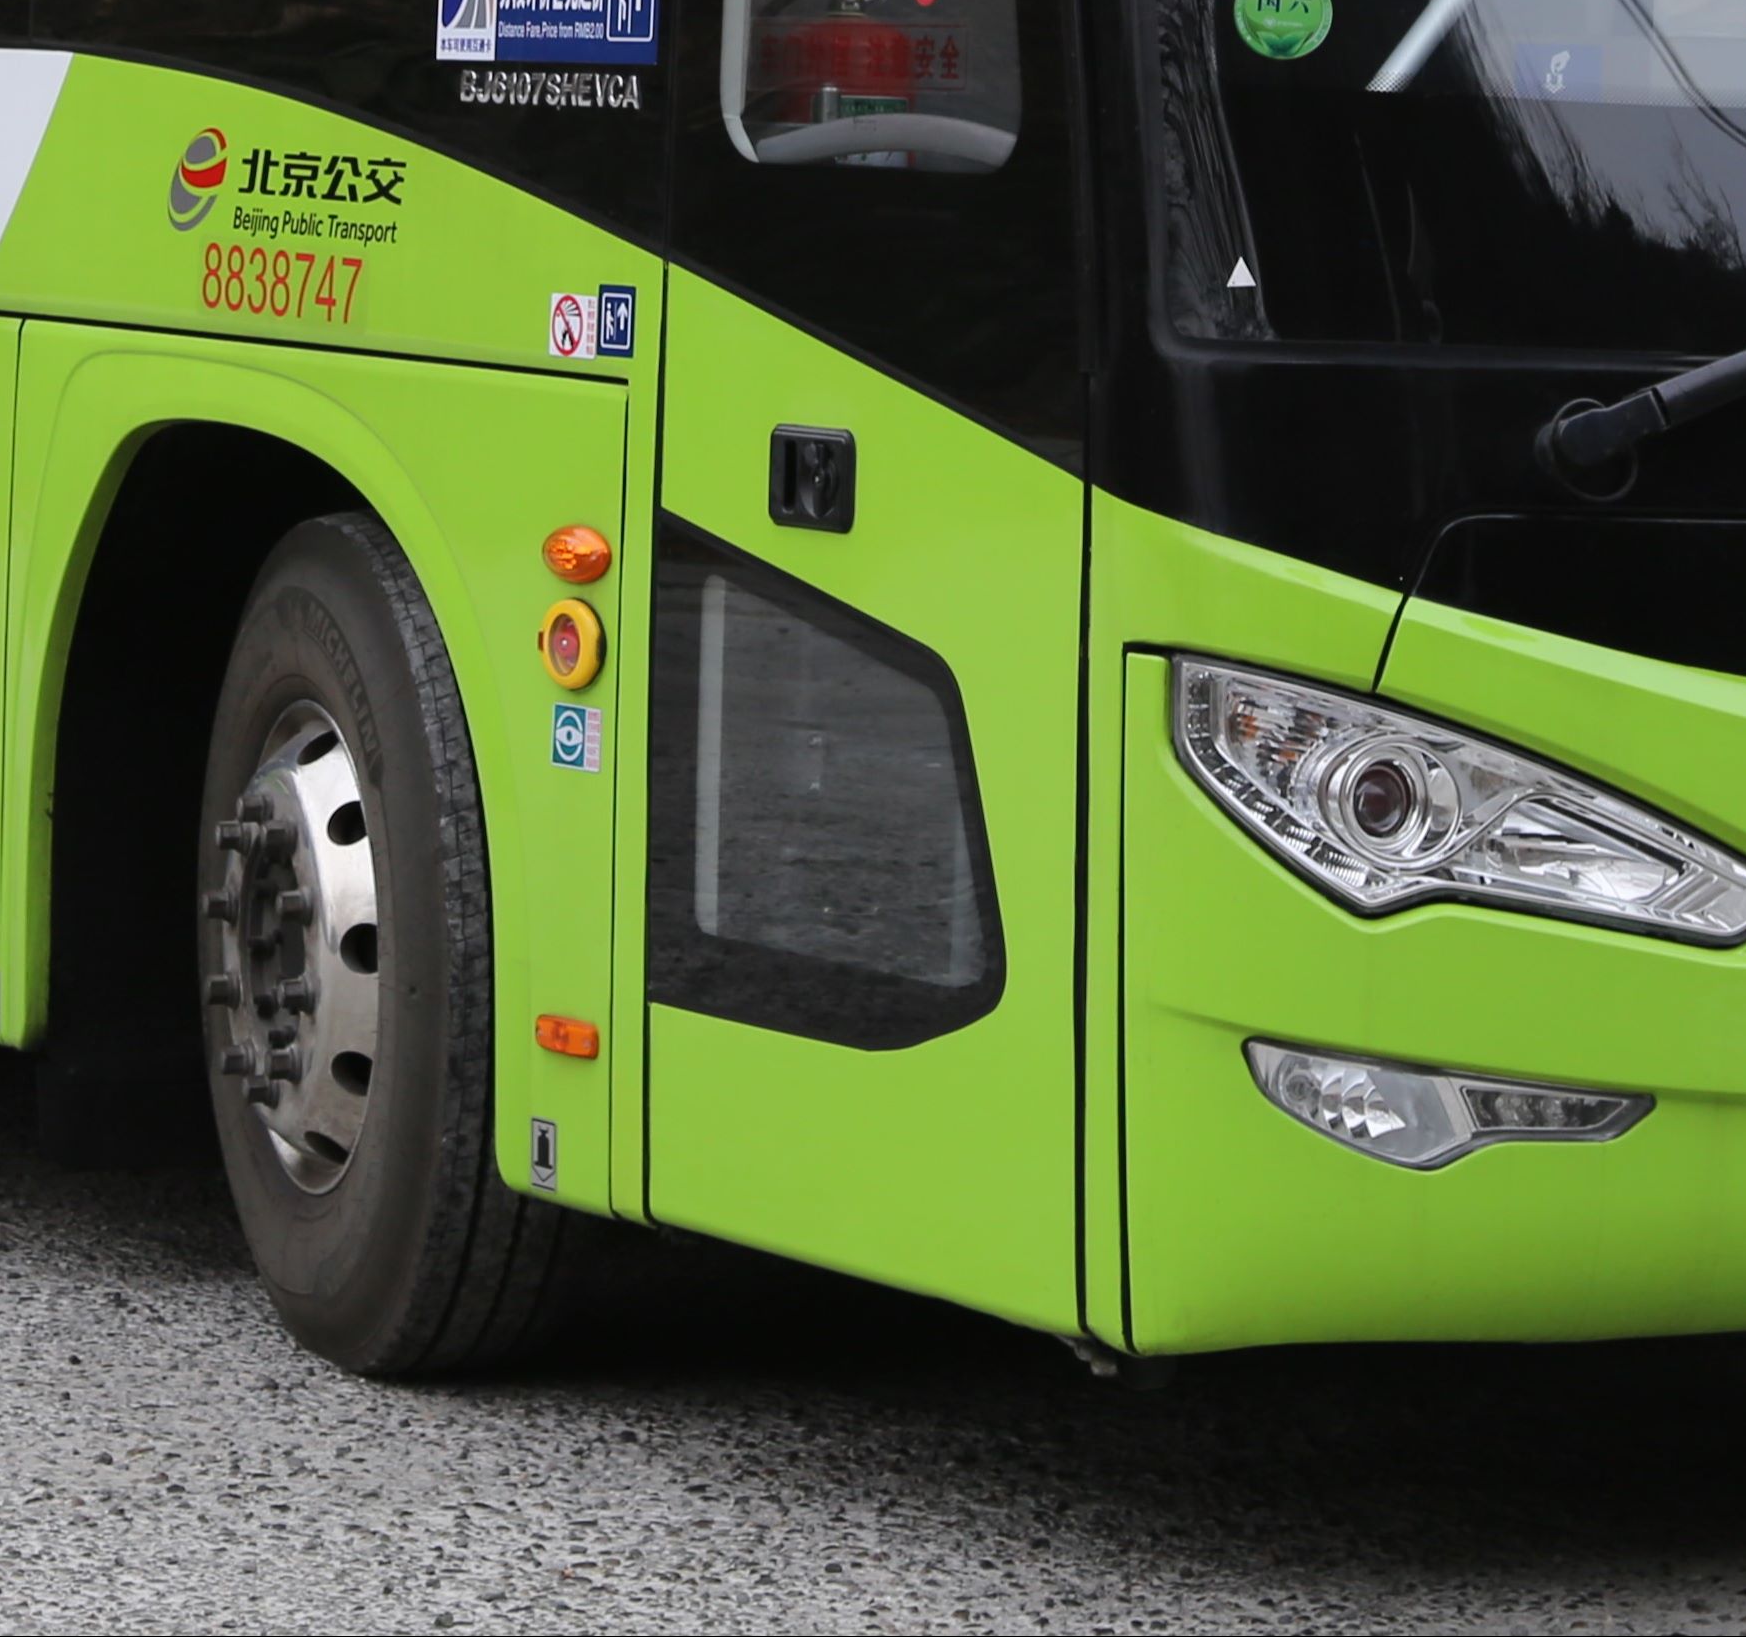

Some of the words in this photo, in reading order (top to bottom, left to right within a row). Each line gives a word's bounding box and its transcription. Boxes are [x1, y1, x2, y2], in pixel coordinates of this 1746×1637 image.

[498, 21, 524, 38] Distance
[460, 69, 640, 110] BJ6107SHEVCA
[238, 148, 407, 205] 北京公交
[232, 206, 280, 240] Beijing
[281, 210, 323, 238] Public
[328, 214, 398, 247] Transport
[202, 242, 363, 324] 8838747
[304, 600, 377, 756] MICHELIN
